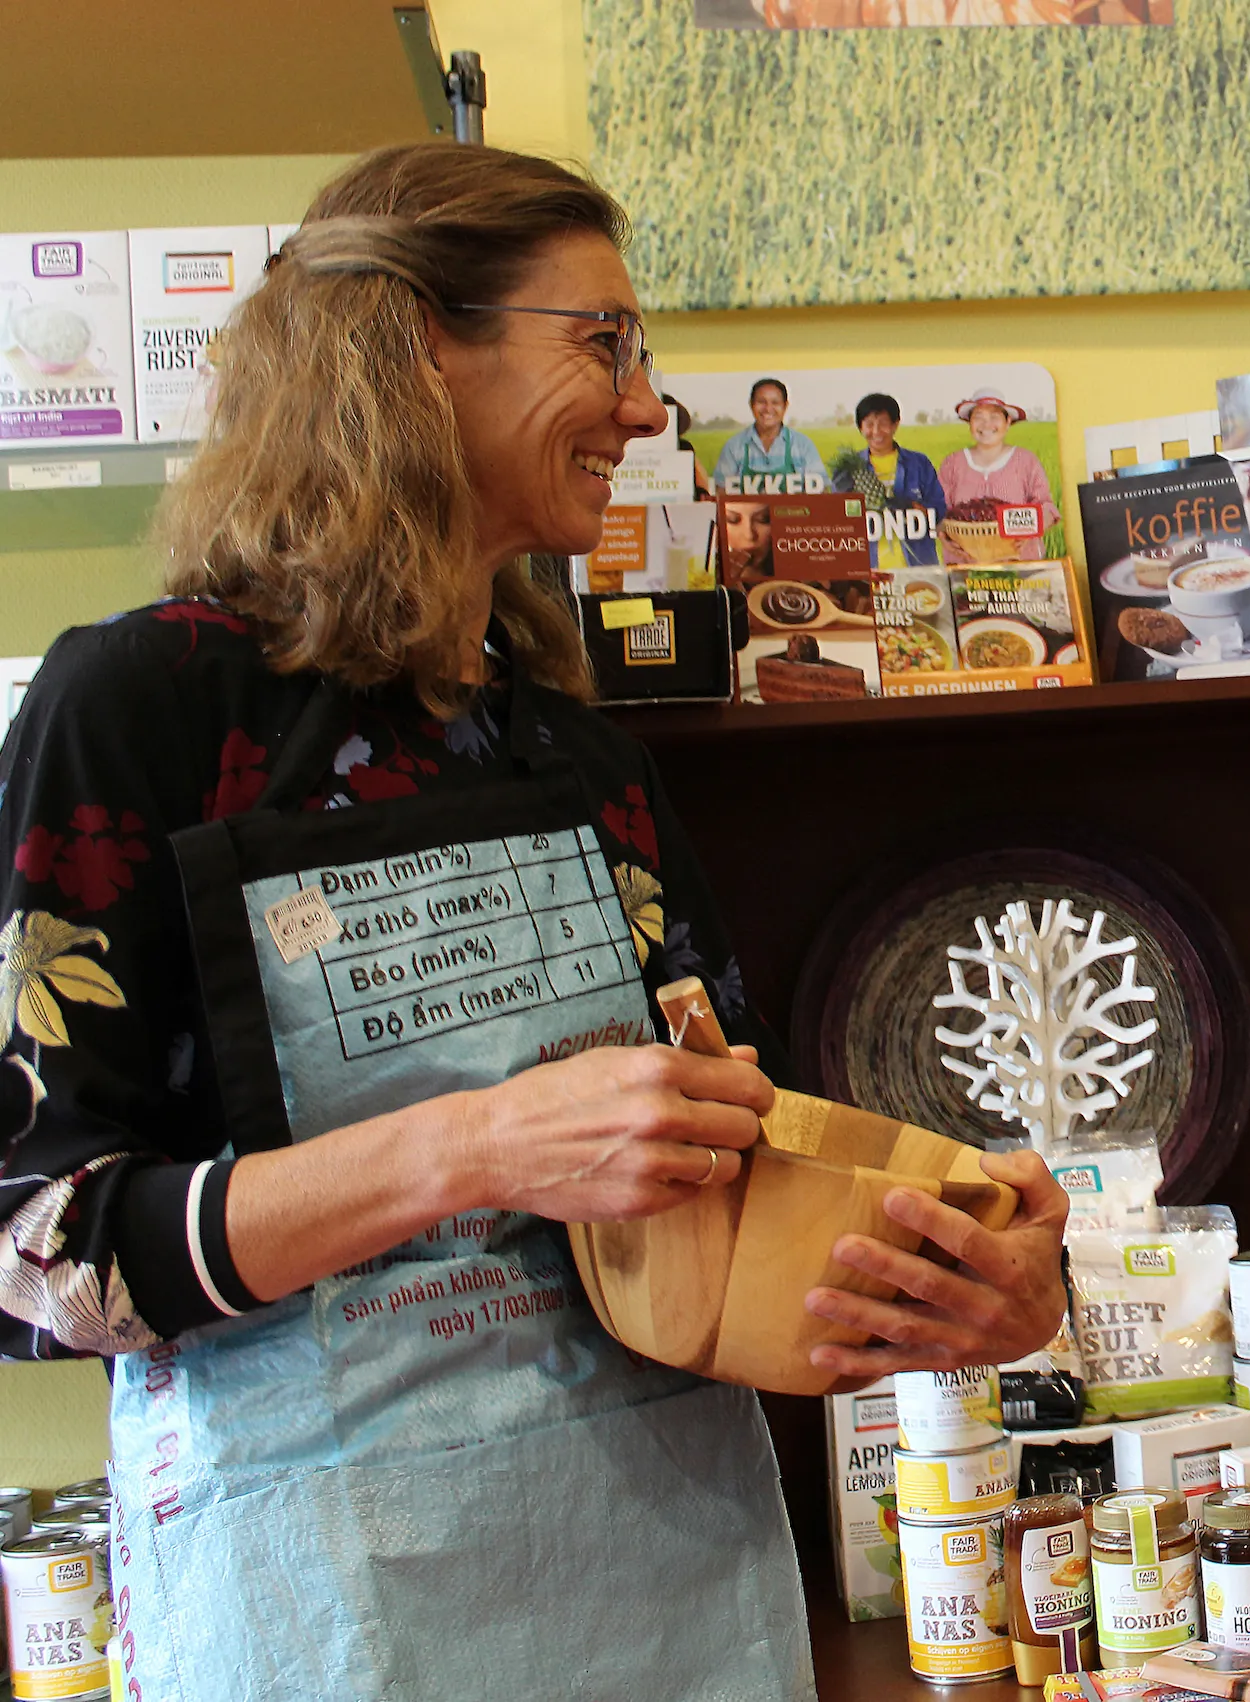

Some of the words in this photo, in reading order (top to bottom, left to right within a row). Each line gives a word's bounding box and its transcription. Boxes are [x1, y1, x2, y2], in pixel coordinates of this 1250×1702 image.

[147, 349, 197, 371] RIJST
[0, 387, 117, 406] BASMATI
[1124, 487, 1162, 499] RECEPTEN
[1164, 483, 1184, 493] VOOR
[1125, 496, 1242, 547] koffie
[776, 538, 866, 553] CHOCOLADE
[967, 590, 992, 602] MET
[320, 869, 380, 895] Đạm
[427, 883, 511, 926] (max%)
[559, 918, 574, 939] 5
[349, 960, 406, 993] Béo
[574, 959, 596, 982] 11
[362, 1009, 405, 1042] Độ
[460, 972, 542, 1019] (max%)
[1133, 1259, 1166, 1268] TRADE
[1135, 1250, 1162, 1260] FAIR
[388, 1274, 445, 1314] phẩm
[449, 1266, 507, 1296] không
[429, 1307, 476, 1341] ngày
[1081, 1301, 1166, 1327] RIET
[1084, 1327, 1138, 1354] SUI
[1086, 1353, 1163, 1383] KER
[846, 1472, 886, 1493] LEMON
[950, 1544, 979, 1555] TRADE
[952, 1536, 976, 1546] FAIR
[56, 1570, 86, 1581] TRADE
[59, 1562, 83, 1573] FAIR
[1139, 1570, 1156, 1579] FAIR
[1137, 1577, 1158, 1585] TRADE
[921, 1594, 980, 1617] ANA
[1034, 1589, 1074, 1602] VLOEIBARE
[1034, 1591, 1092, 1614] HONING
[922, 1619, 977, 1641] NAS
[1112, 1608, 1188, 1630] HONING
[26, 1618, 88, 1643] ANA
[27, 1641, 83, 1666] NAS
[958, 1647, 970, 1655] op
